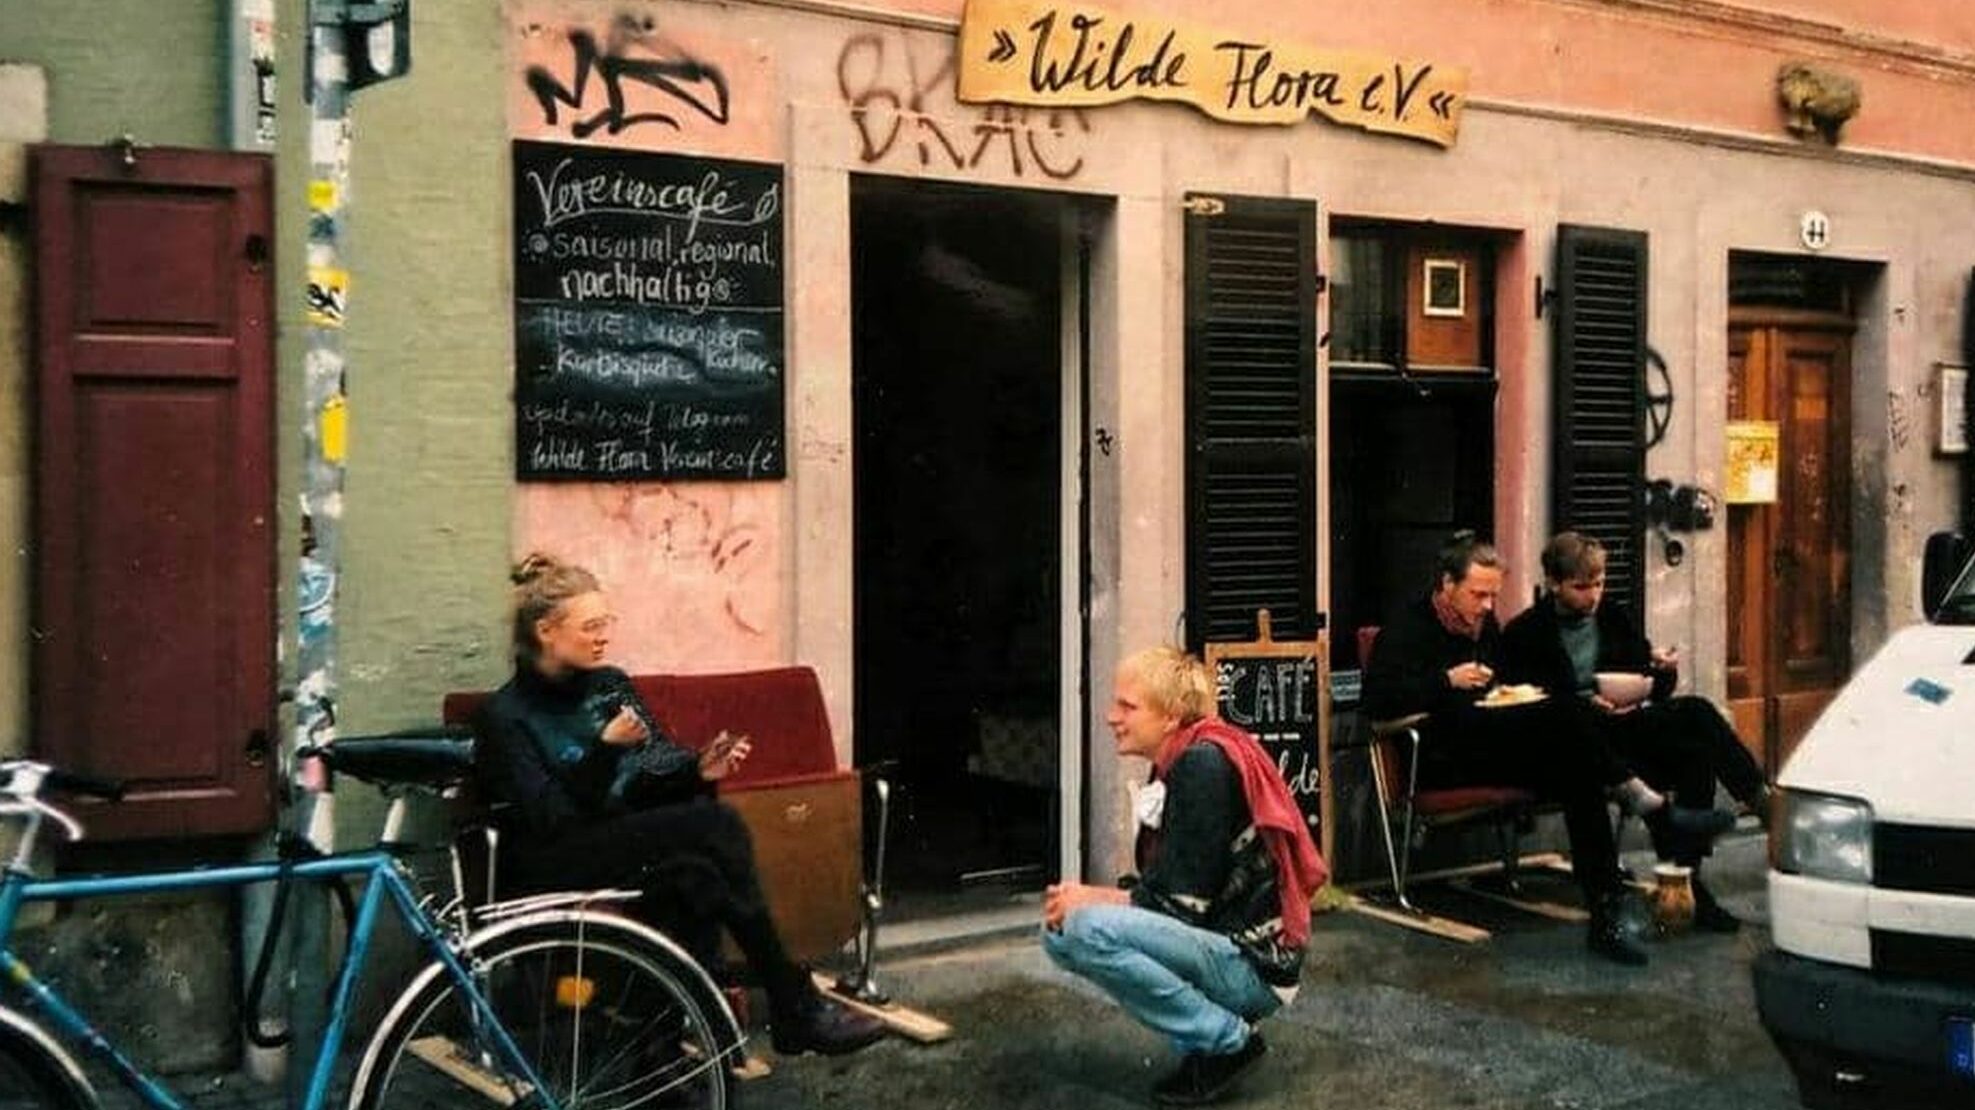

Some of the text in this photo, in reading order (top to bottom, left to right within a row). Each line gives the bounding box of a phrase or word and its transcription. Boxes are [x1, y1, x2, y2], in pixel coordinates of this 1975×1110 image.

[527, 157, 745, 245] Vereinscafé
[1806, 219, 1825, 243] 44
[561, 261, 712, 315] nachhaltig
[1226, 657, 1315, 725] CAFÉ
